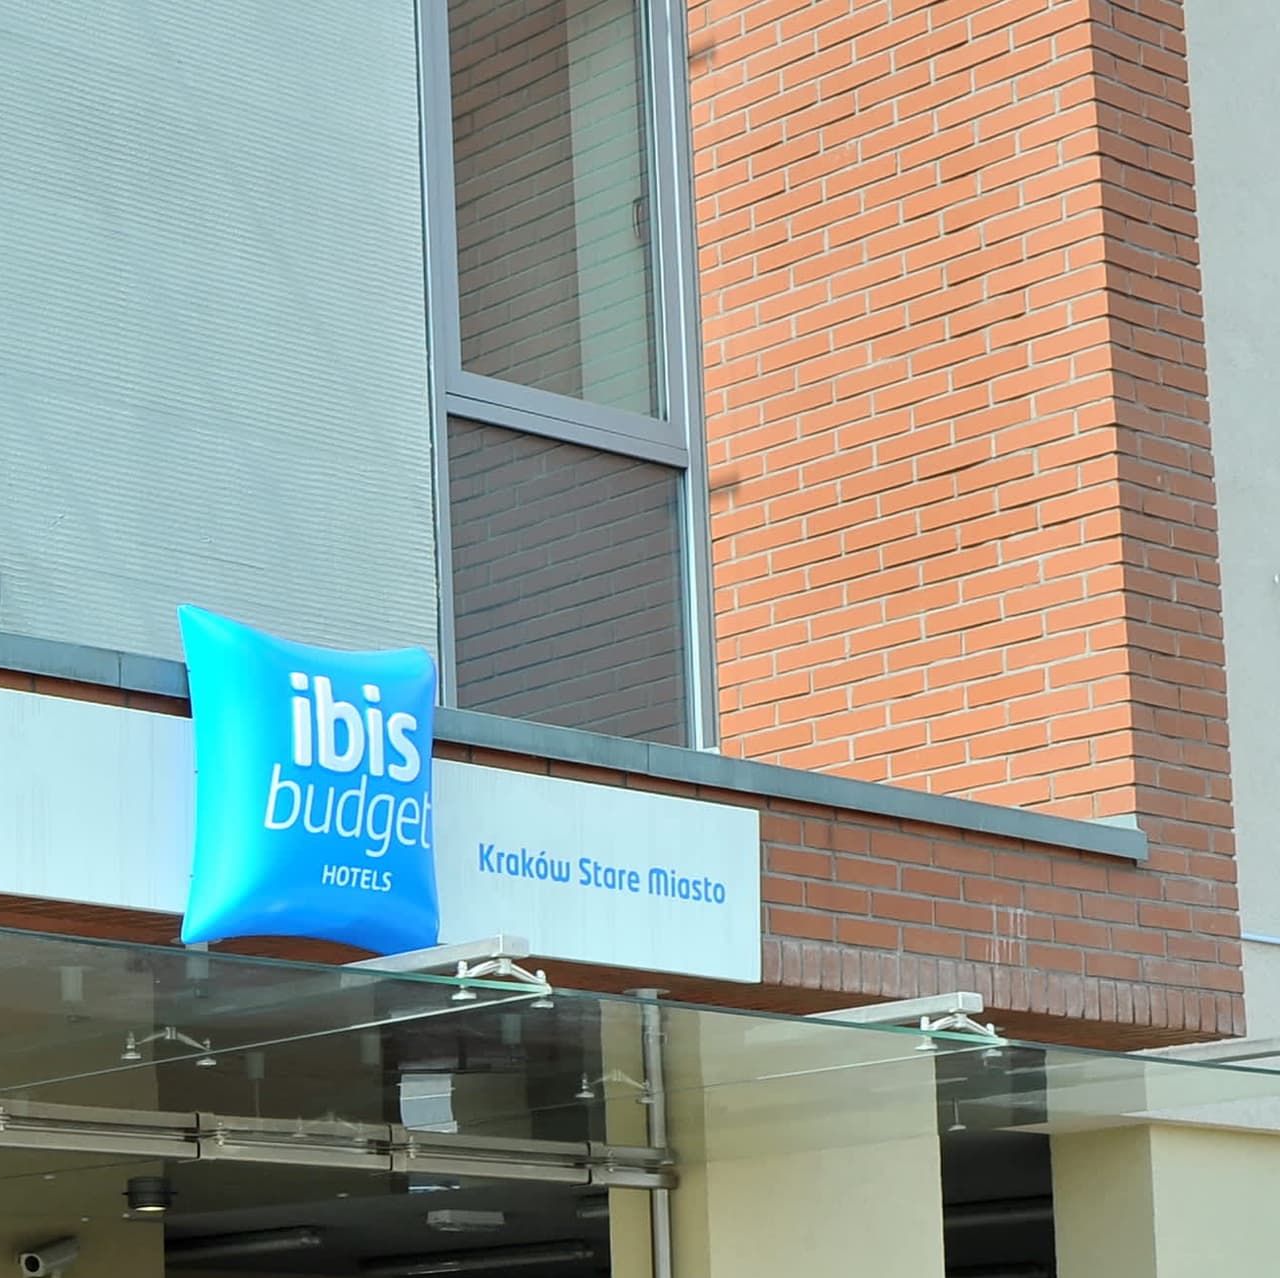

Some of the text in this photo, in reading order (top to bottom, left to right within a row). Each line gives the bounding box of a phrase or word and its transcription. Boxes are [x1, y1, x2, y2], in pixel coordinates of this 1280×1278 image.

[290, 672, 421, 782] ibis
[264, 763, 431, 857] budget
[322, 864, 392, 892] HOTELS
[479, 843, 726, 904] Kraków Stare Miasto
